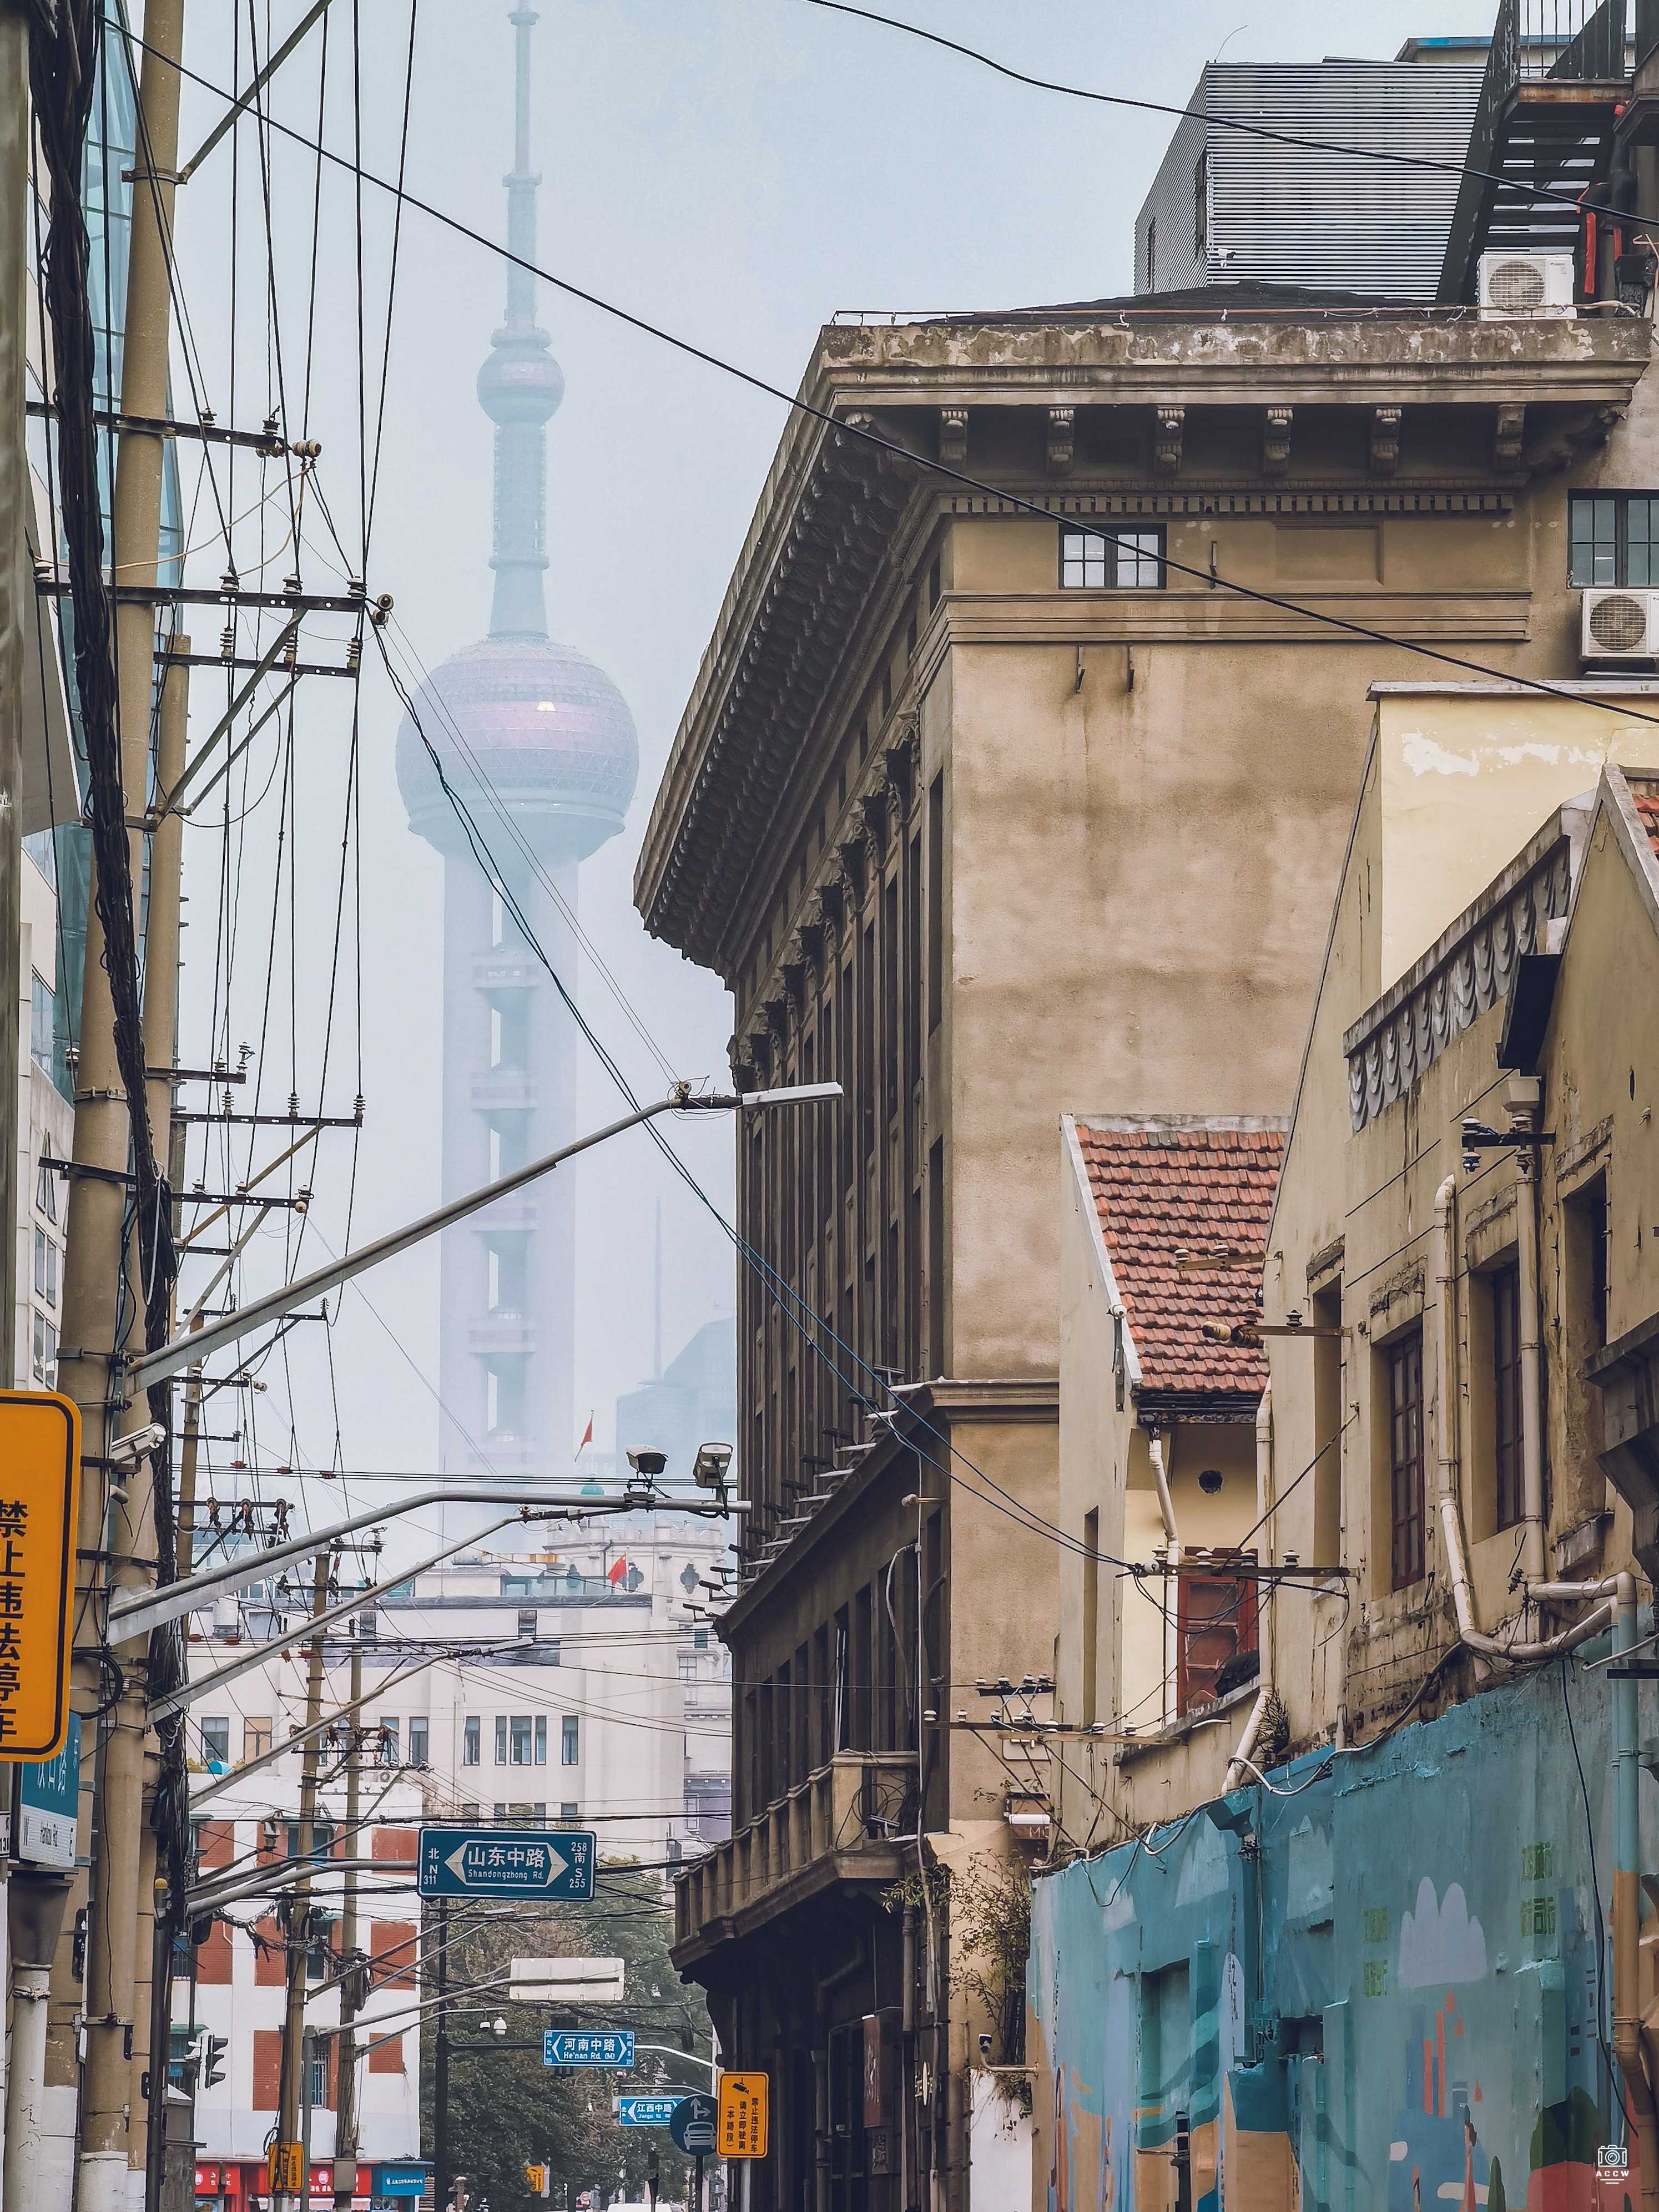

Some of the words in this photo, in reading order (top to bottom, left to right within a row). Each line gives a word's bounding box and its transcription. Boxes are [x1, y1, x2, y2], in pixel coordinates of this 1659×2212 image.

[571, 1841, 587, 1852] 258
[428, 1847, 440, 1860] 北
[468, 1846, 545, 1868] 山东中路
[574, 1852, 586, 1864] 南
[429, 1864, 438, 1874] N
[468, 1868, 528, 1881] Shandongzhong
[574, 1867, 583, 1878] S
[423, 1874, 437, 1885] 311
[569, 1878, 586, 1888] 255
[564, 2038, 616, 2052] 河南中路
[637, 2103, 672, 2113] 江西中路
[750, 2097, 759, 2153] 禁止违法停车
